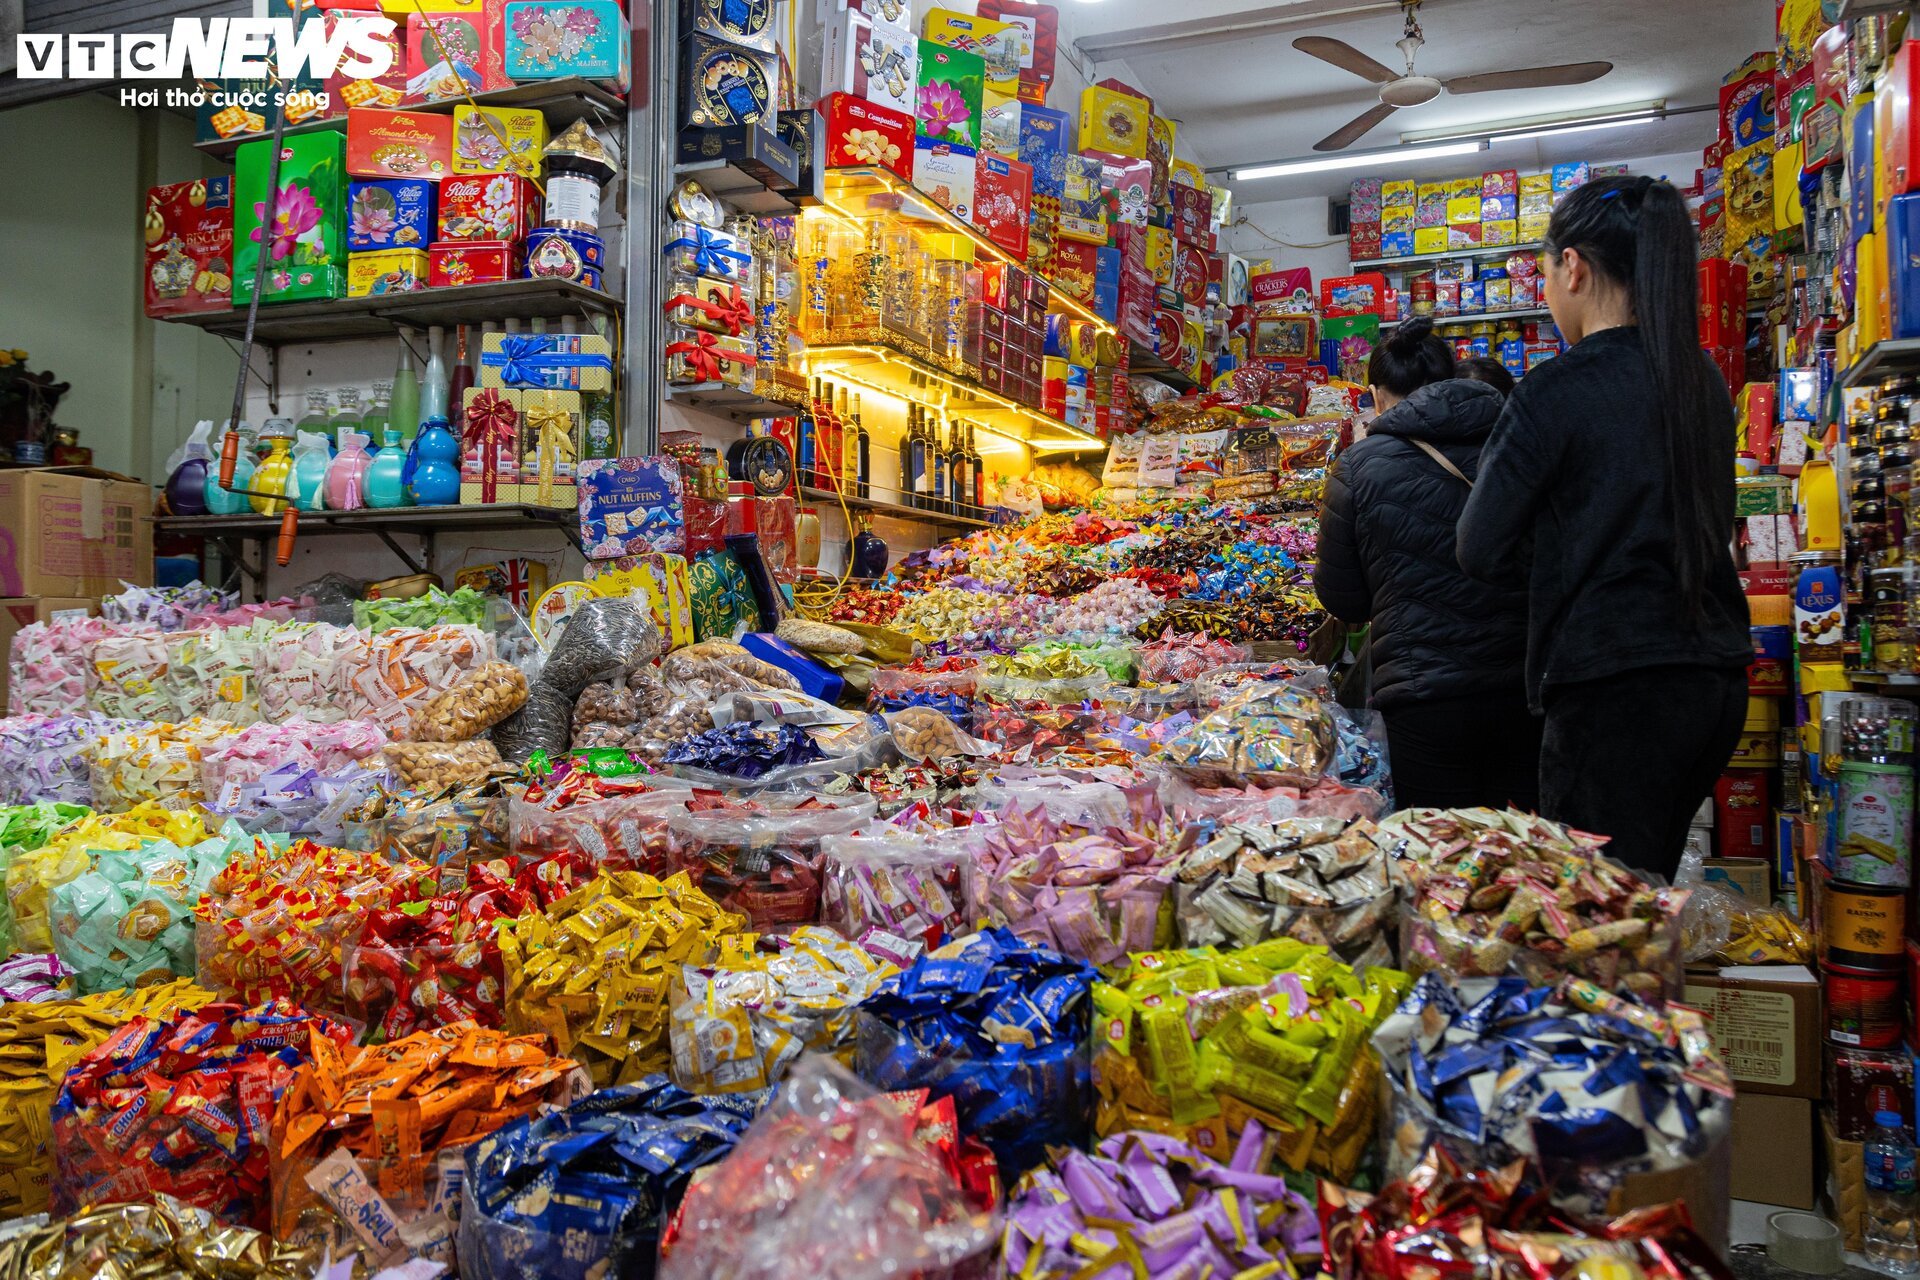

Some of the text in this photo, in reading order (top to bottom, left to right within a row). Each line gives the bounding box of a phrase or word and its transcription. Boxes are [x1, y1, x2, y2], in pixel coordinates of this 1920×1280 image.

[867, 112, 903, 130] Composition
[445, 182, 481, 198] Ritaz
[450, 194, 475, 203] GOLD
[1060, 250, 1083, 263] ROYAL
[1255, 280, 1288, 293] CRACKERS
[598, 491, 662, 504] NUT MUFFINS
[1801, 593, 1834, 606] LEXUS
[1851, 801, 1887, 814] MERRY
[1846, 908, 1887, 919] RAISINS
[113, 1095, 147, 1136] CHOCO
